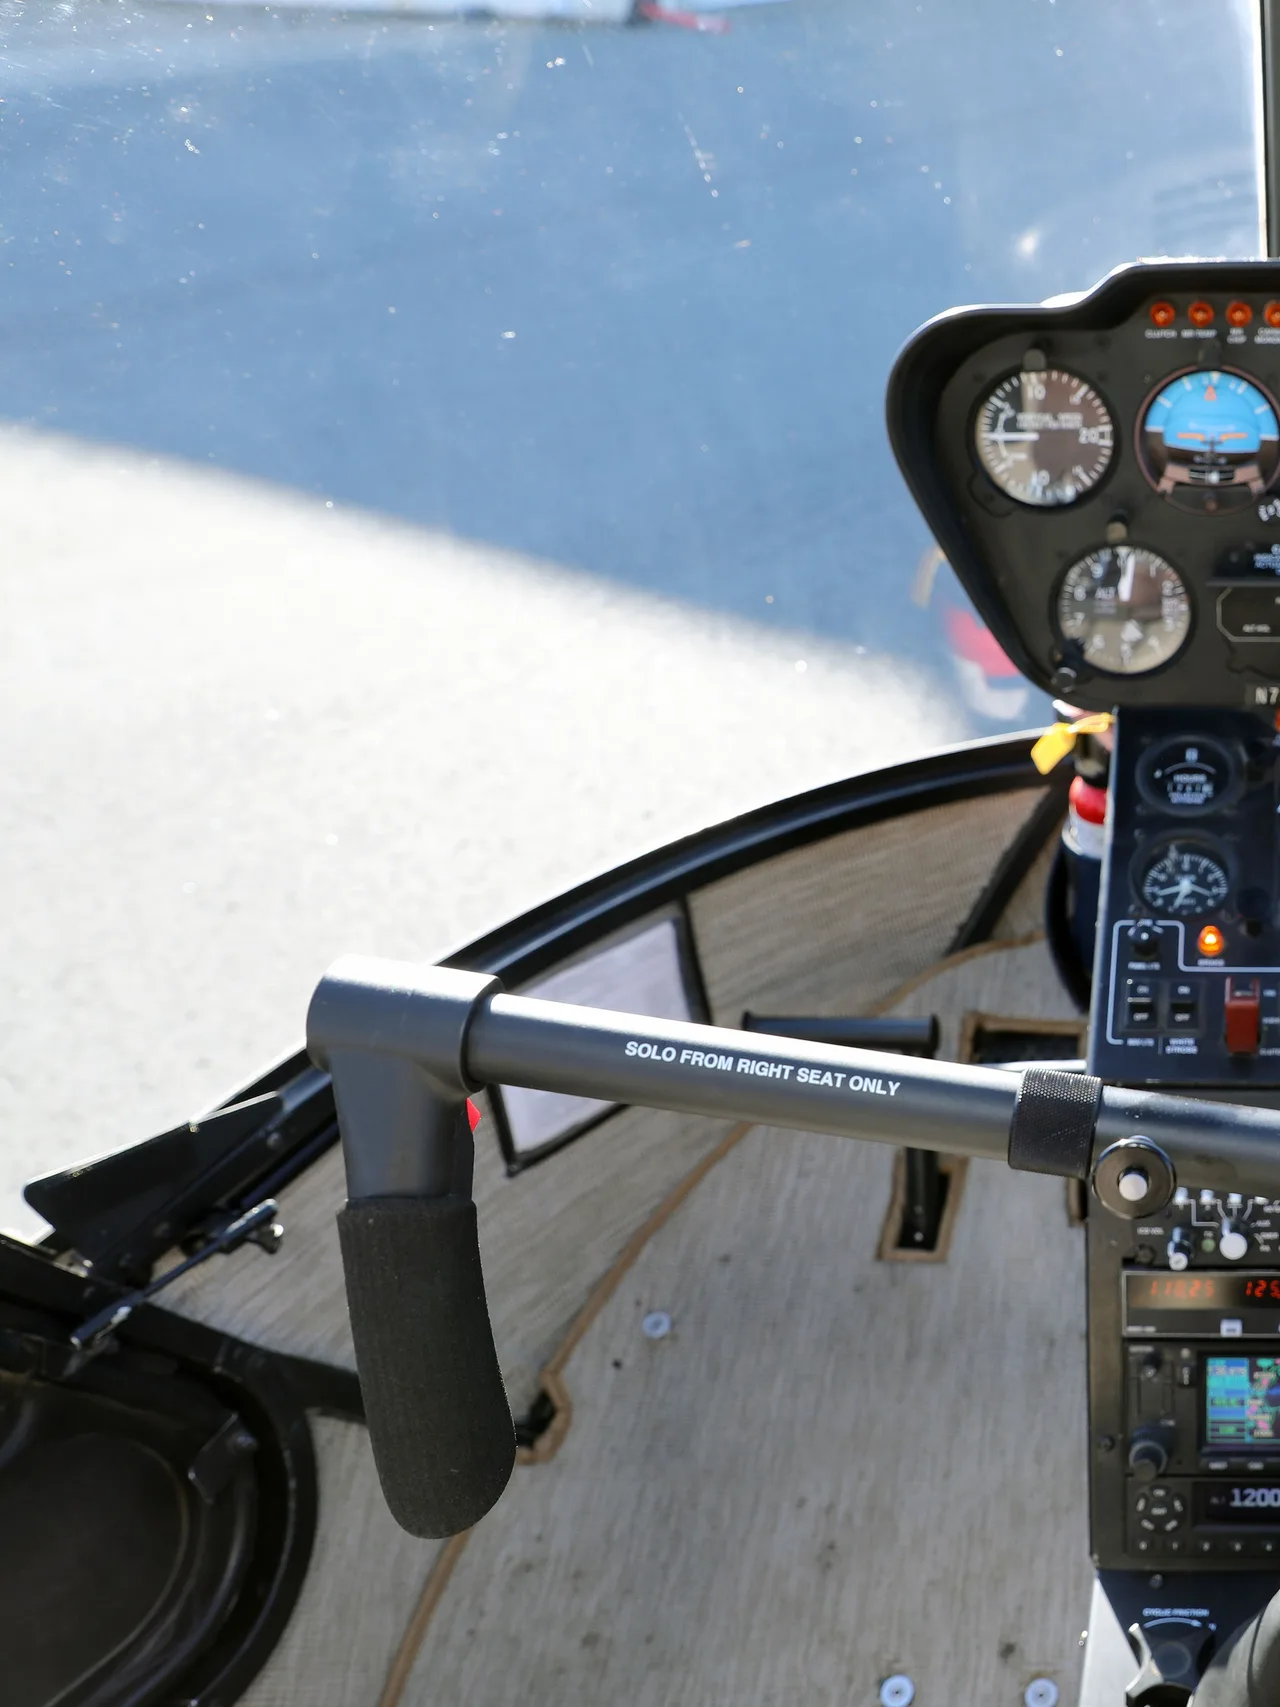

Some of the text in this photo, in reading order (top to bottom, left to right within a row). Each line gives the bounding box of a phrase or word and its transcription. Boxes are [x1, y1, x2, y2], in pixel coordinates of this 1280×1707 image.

[624, 1040, 901, 1097] SOLO FROM RIGHT SEAT ONLY
